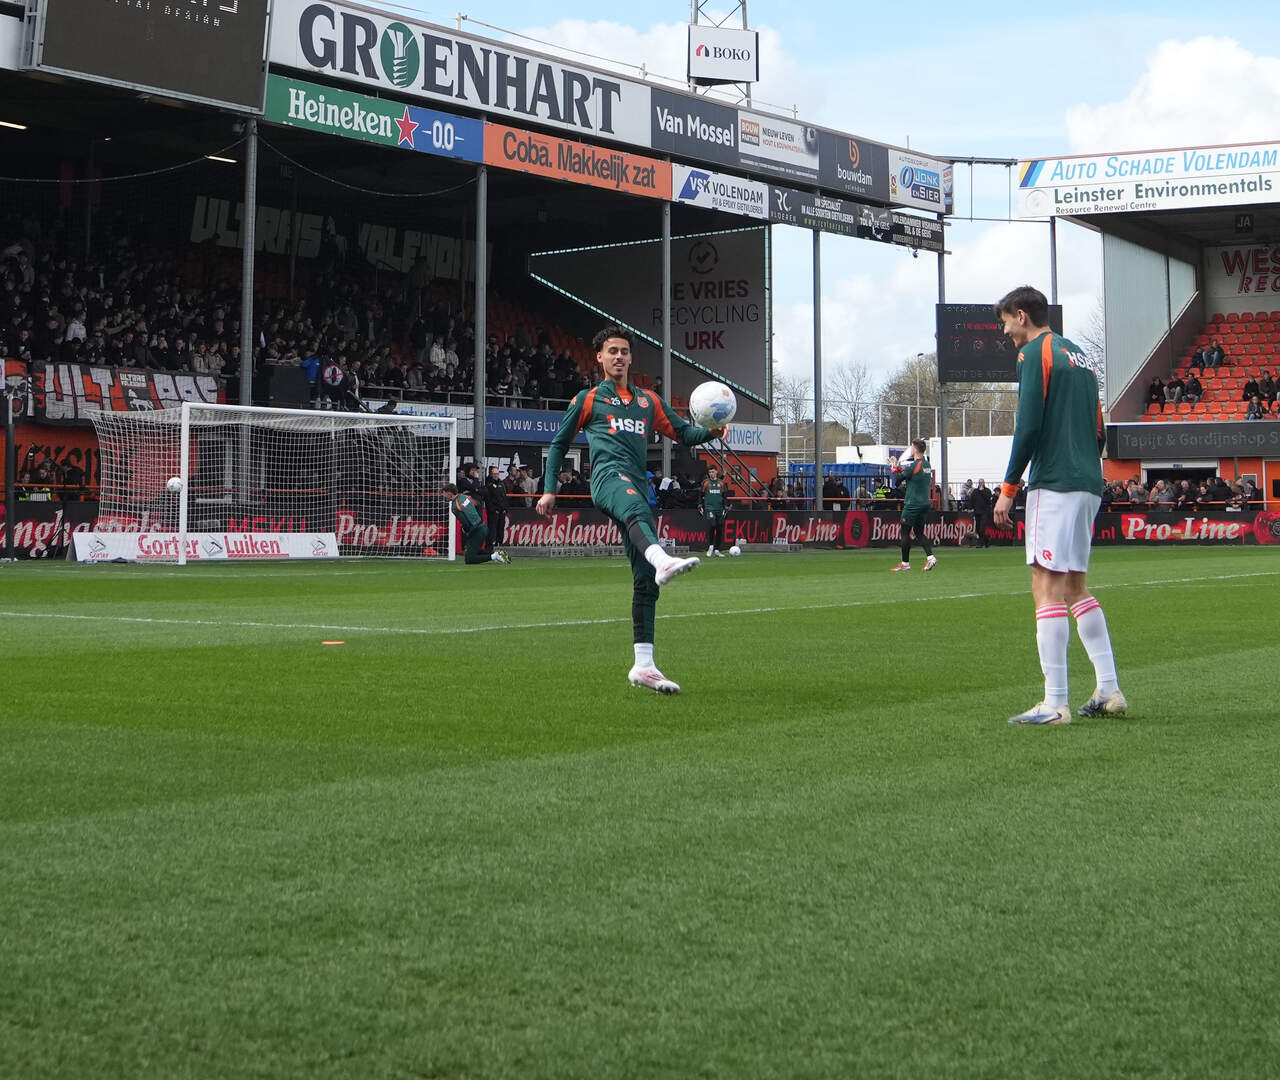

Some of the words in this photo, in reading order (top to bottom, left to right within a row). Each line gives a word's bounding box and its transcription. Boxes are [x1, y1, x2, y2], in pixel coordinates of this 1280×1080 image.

[713, 46, 750, 61] BOKO
[288, 87, 393, 138] Heineken
[656, 106, 684, 136] Van
[687, 113, 735, 148] Mossel
[762, 127, 779, 139] NIEUW
[779, 131, 795, 142] LEVEN
[503, 131, 553, 170] Coba.
[557, 143, 631, 189] Makkelijk
[632, 167, 657, 189] zat
[1051, 161, 1097, 182] AUTO
[1105, 156, 1176, 178] SCHADE
[1183, 150, 1279, 172] VOLENDAM
[837, 163, 873, 186] bouwdam
[689, 176, 711, 194] VSK
[712, 181, 764, 205] VOLENDAM
[920, 187, 940, 202] SIER
[1054, 186, 1124, 205] Leinster
[1135, 175, 1273, 199] Environmentals
[1056, 204, 1092, 215] Resource
[1094, 203, 1129, 213] Renewal
[1130, 200, 1157, 211] Centre
[1236, 216, 1252, 229] JA
[690, 279, 749, 300] VRIES
[685, 330, 725, 351] URK
[610, 418, 646, 435] HSB
[1122, 431, 1163, 449] Tapijt
[1165, 432, 1176, 446] &
[1179, 431, 1267, 448] Gordijnshop
[337, 512, 439, 547] Pro-Line
[774, 513, 839, 542] Pro-Line
[1127, 517, 1240, 541] Pro-Line
[223, 533, 281, 556] Luiken
